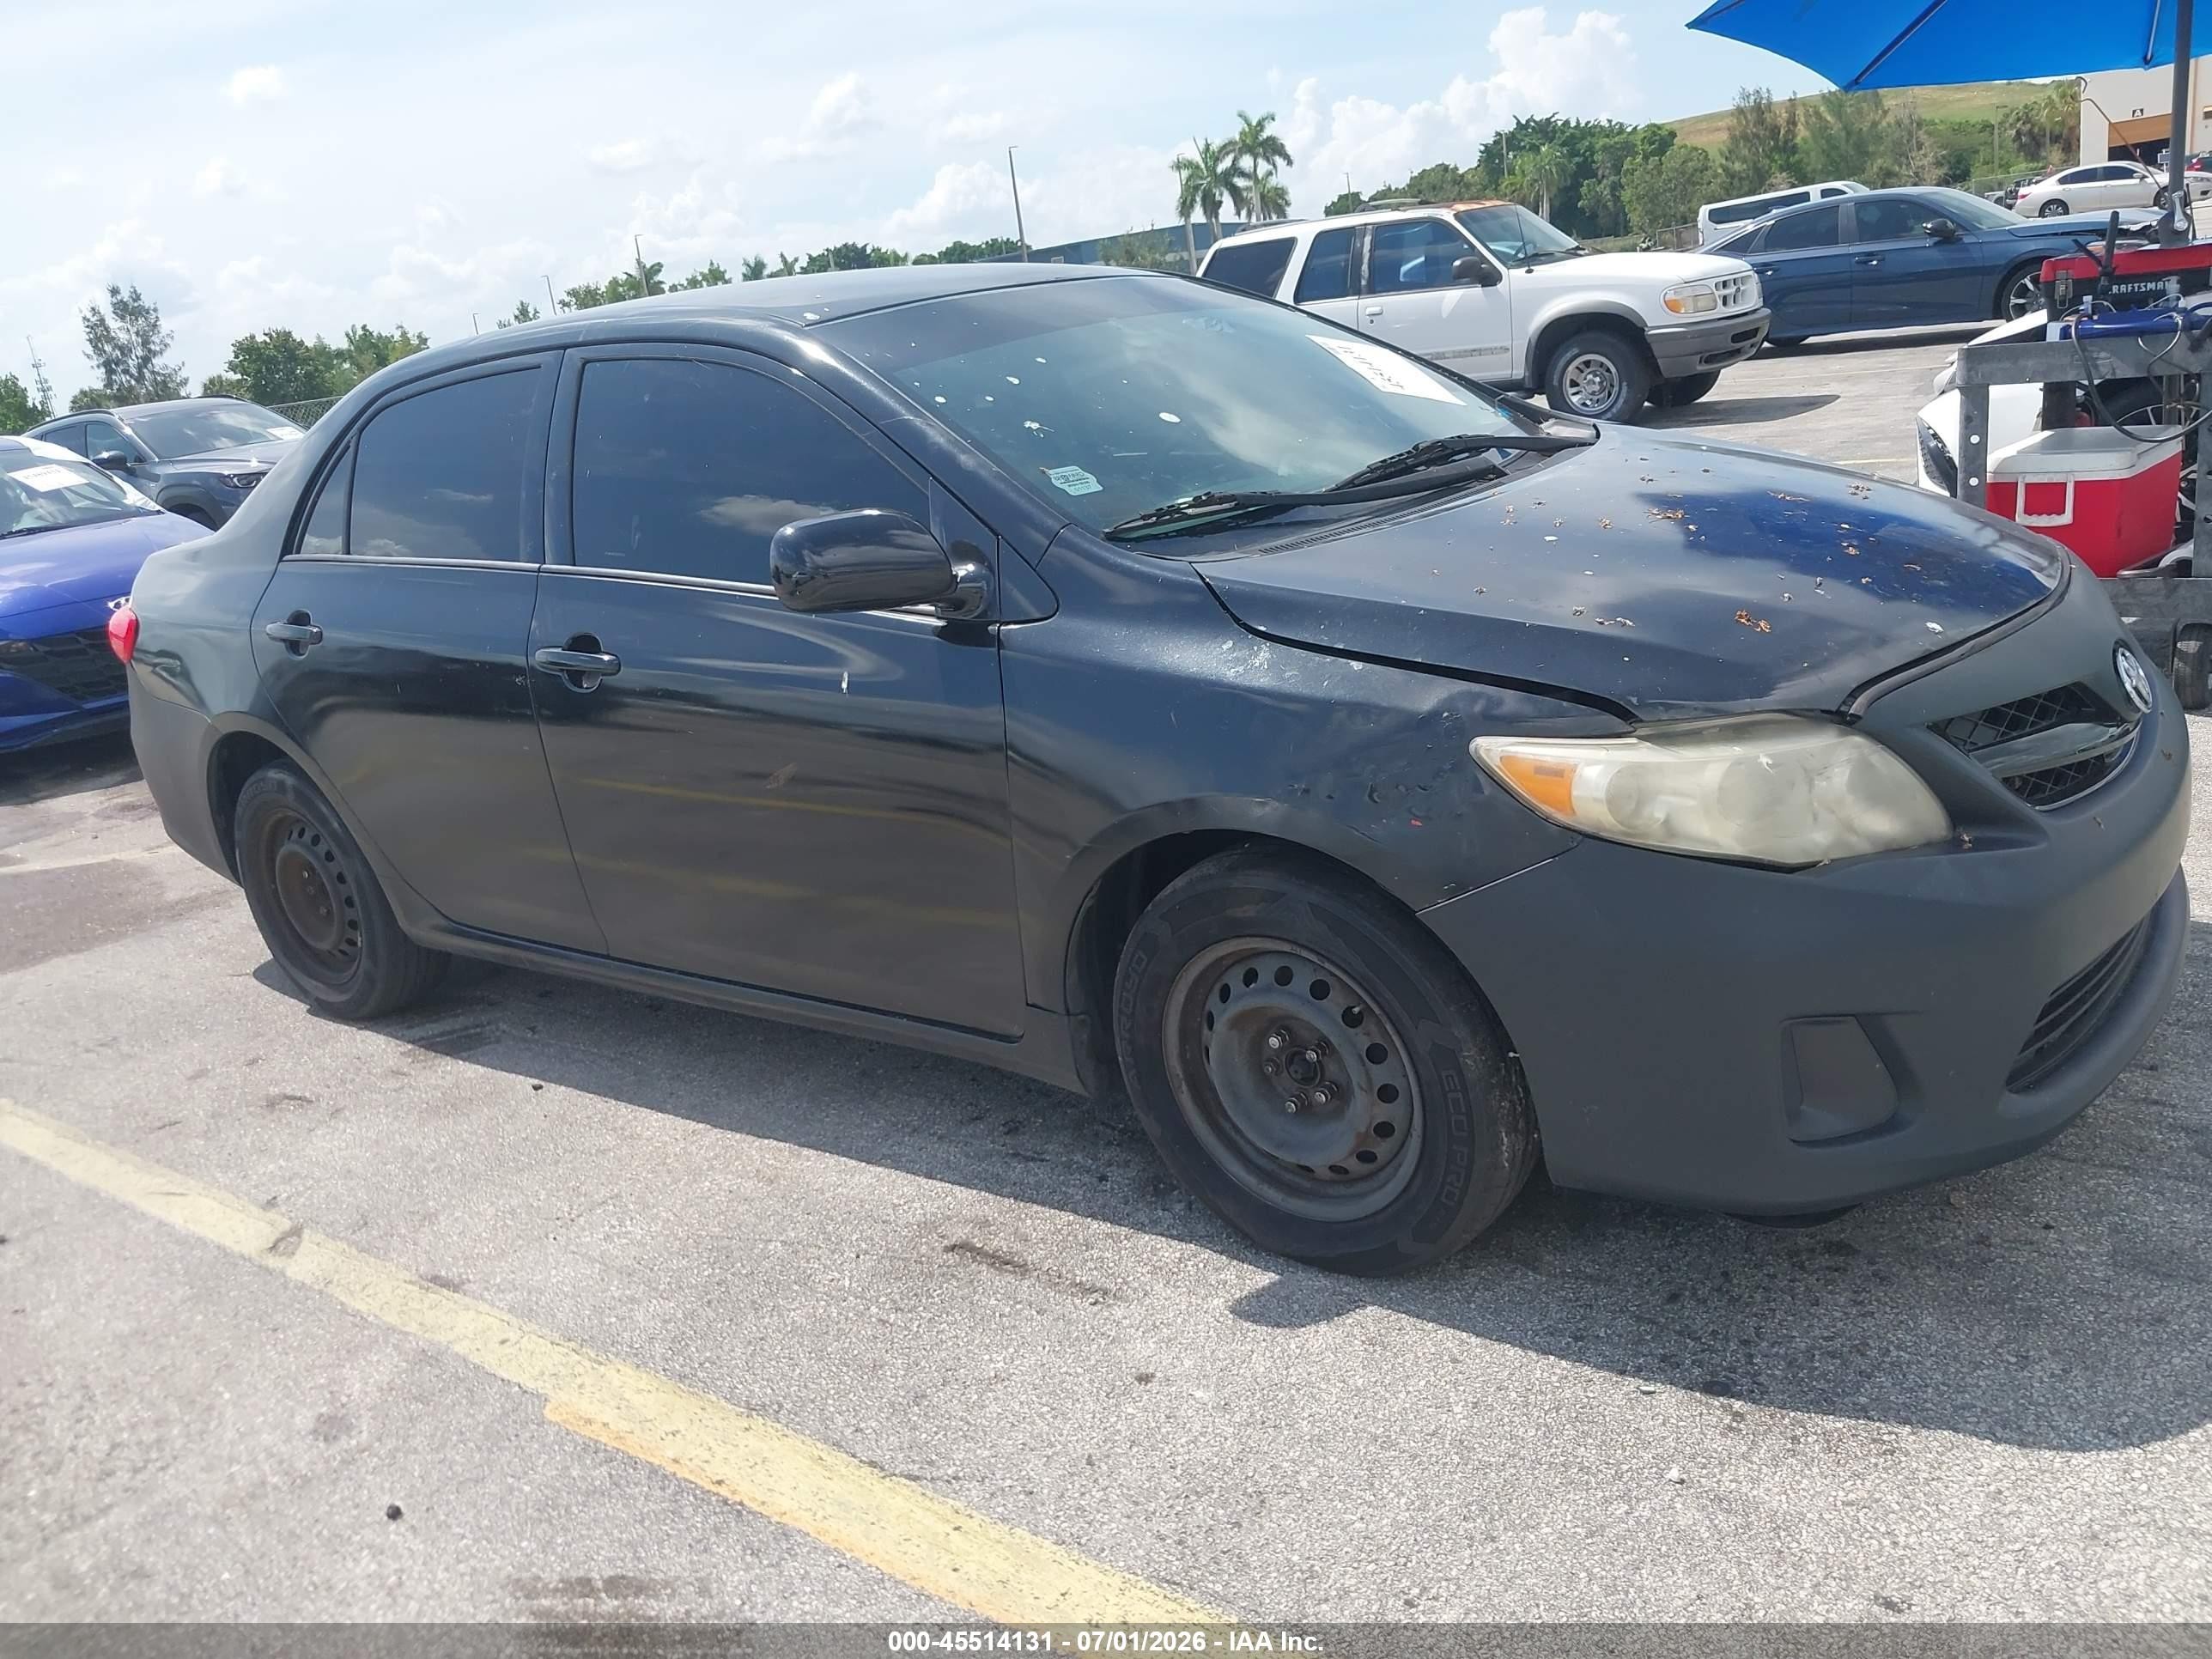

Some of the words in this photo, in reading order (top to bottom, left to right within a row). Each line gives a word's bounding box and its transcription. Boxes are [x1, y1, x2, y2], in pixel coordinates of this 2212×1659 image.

[2109, 281, 2171, 295] RAFTSMA
[1441, 1067, 1469, 1137] ECO
[1440, 1143, 1469, 1206] PRO
